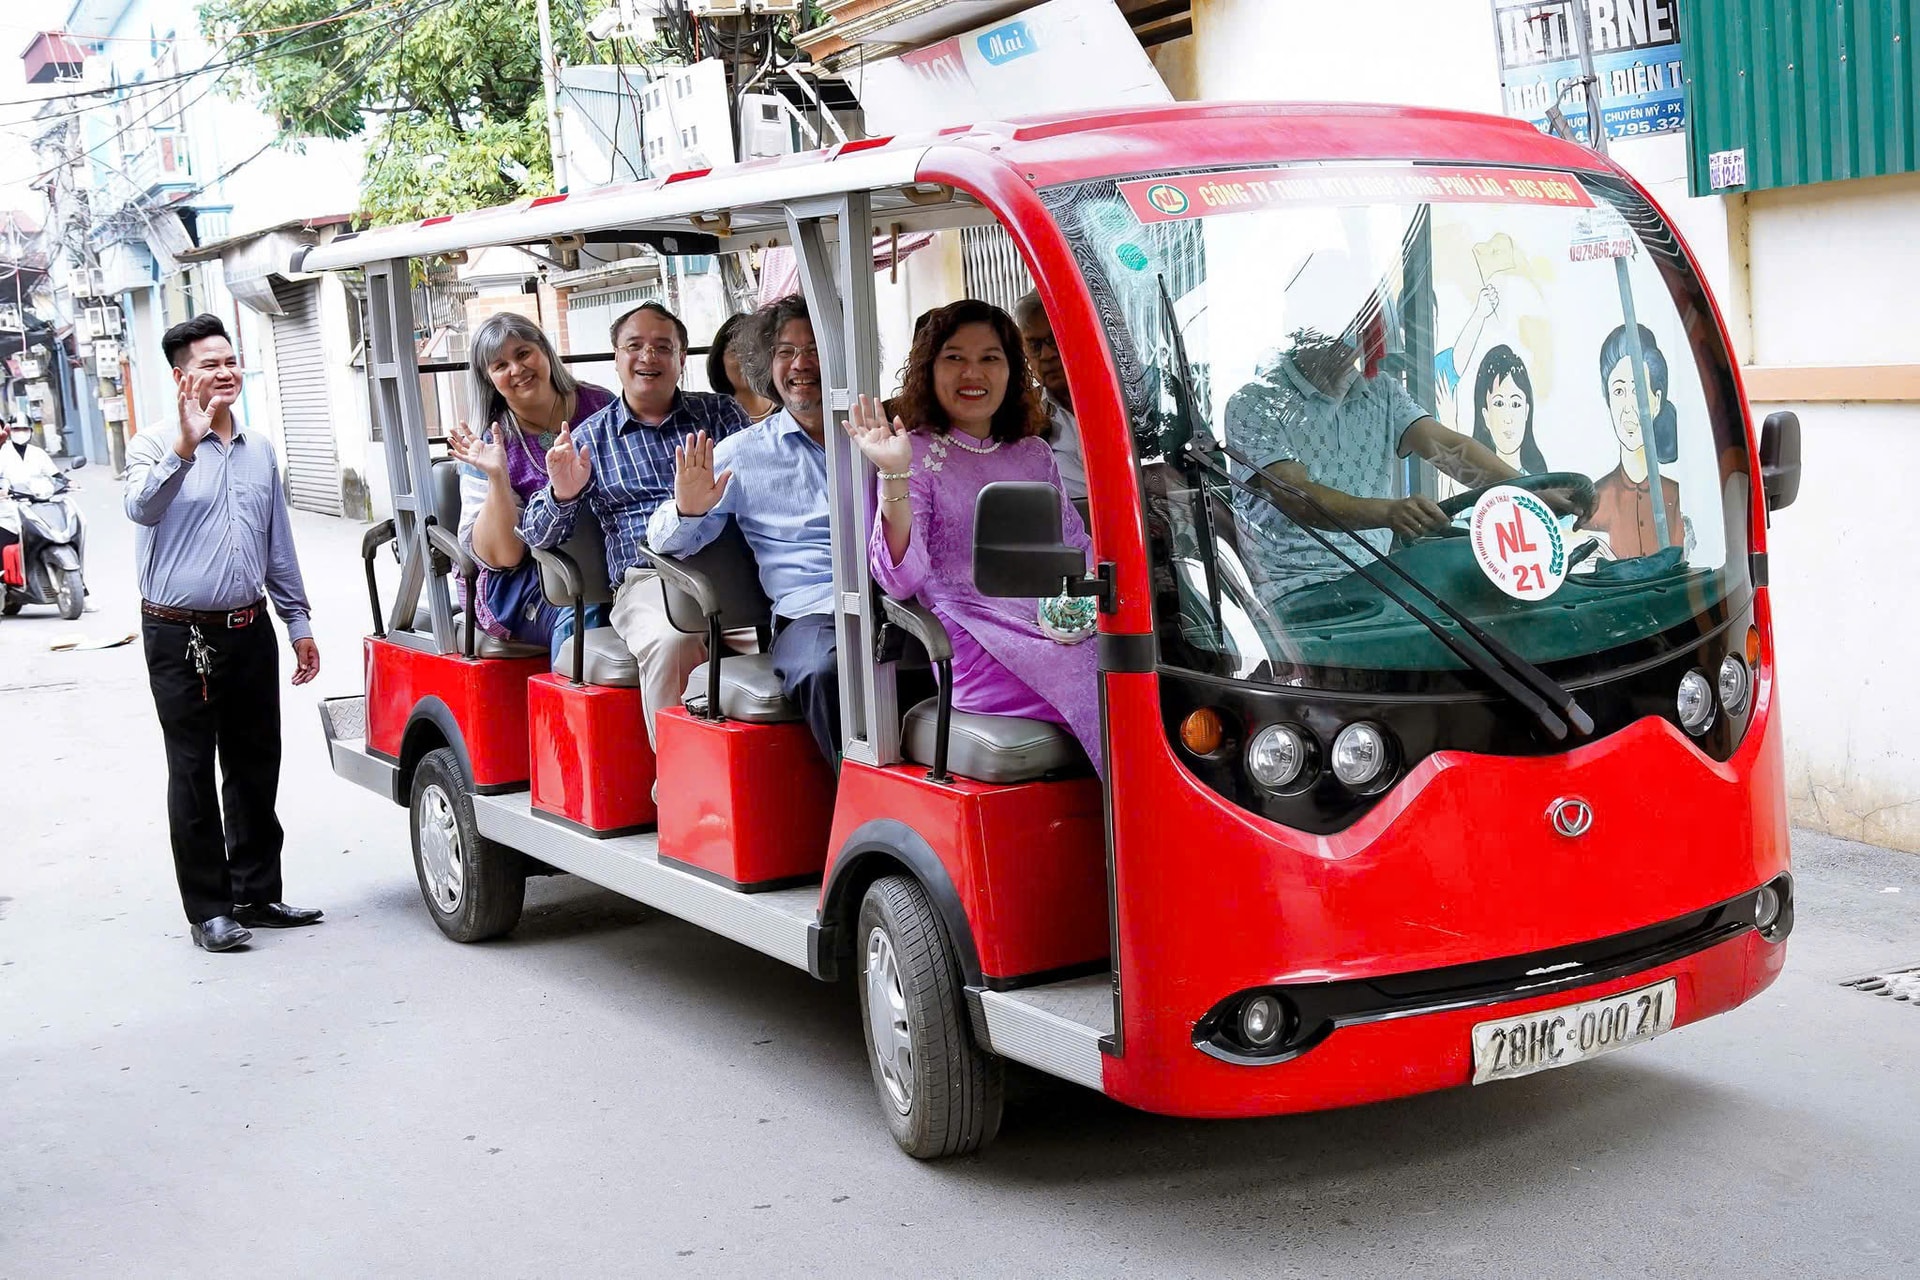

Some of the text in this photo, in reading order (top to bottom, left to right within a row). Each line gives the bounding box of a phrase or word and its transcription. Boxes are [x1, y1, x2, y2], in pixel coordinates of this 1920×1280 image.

[988, 29, 1025, 60] Mai
[1508, 74, 1550, 111] TRÒ
[1611, 60, 1664, 99] ĐIỆN
[1604, 106, 1644, 124] CHUYÊN
[1667, 102, 1682, 114] PX
[1198, 181, 1250, 207] CÔNG
[1246, 182, 1273, 202] TY
[1439, 173, 1475, 196] PHÚ
[1471, 174, 1505, 197] LÃO
[1508, 179, 1545, 200] BUS
[1538, 178, 1579, 204] ĐIỆN
[1494, 502, 1538, 563] NL
[1512, 562, 1546, 592] 21
